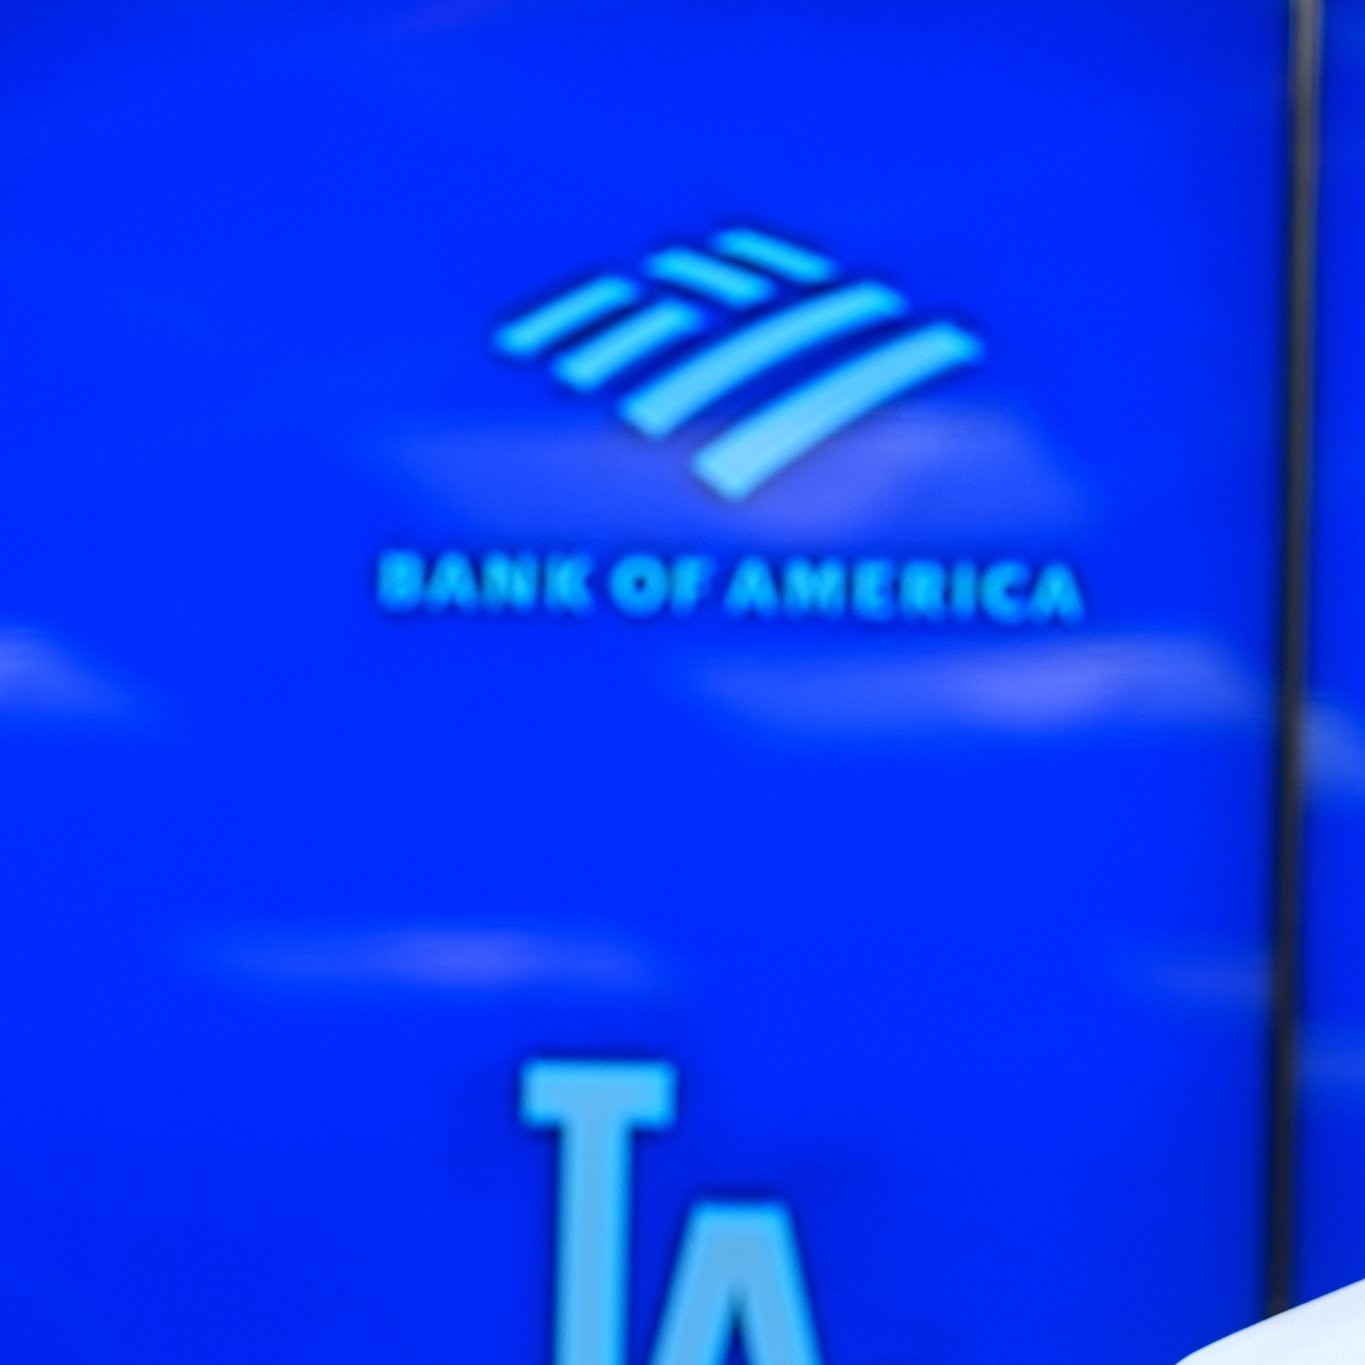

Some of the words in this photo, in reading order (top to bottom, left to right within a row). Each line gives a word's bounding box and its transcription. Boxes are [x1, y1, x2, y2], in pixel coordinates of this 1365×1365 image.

[378, 549, 590, 615] BANK
[609, 554, 713, 617] OF
[726, 557, 1083, 624] AMERICA
